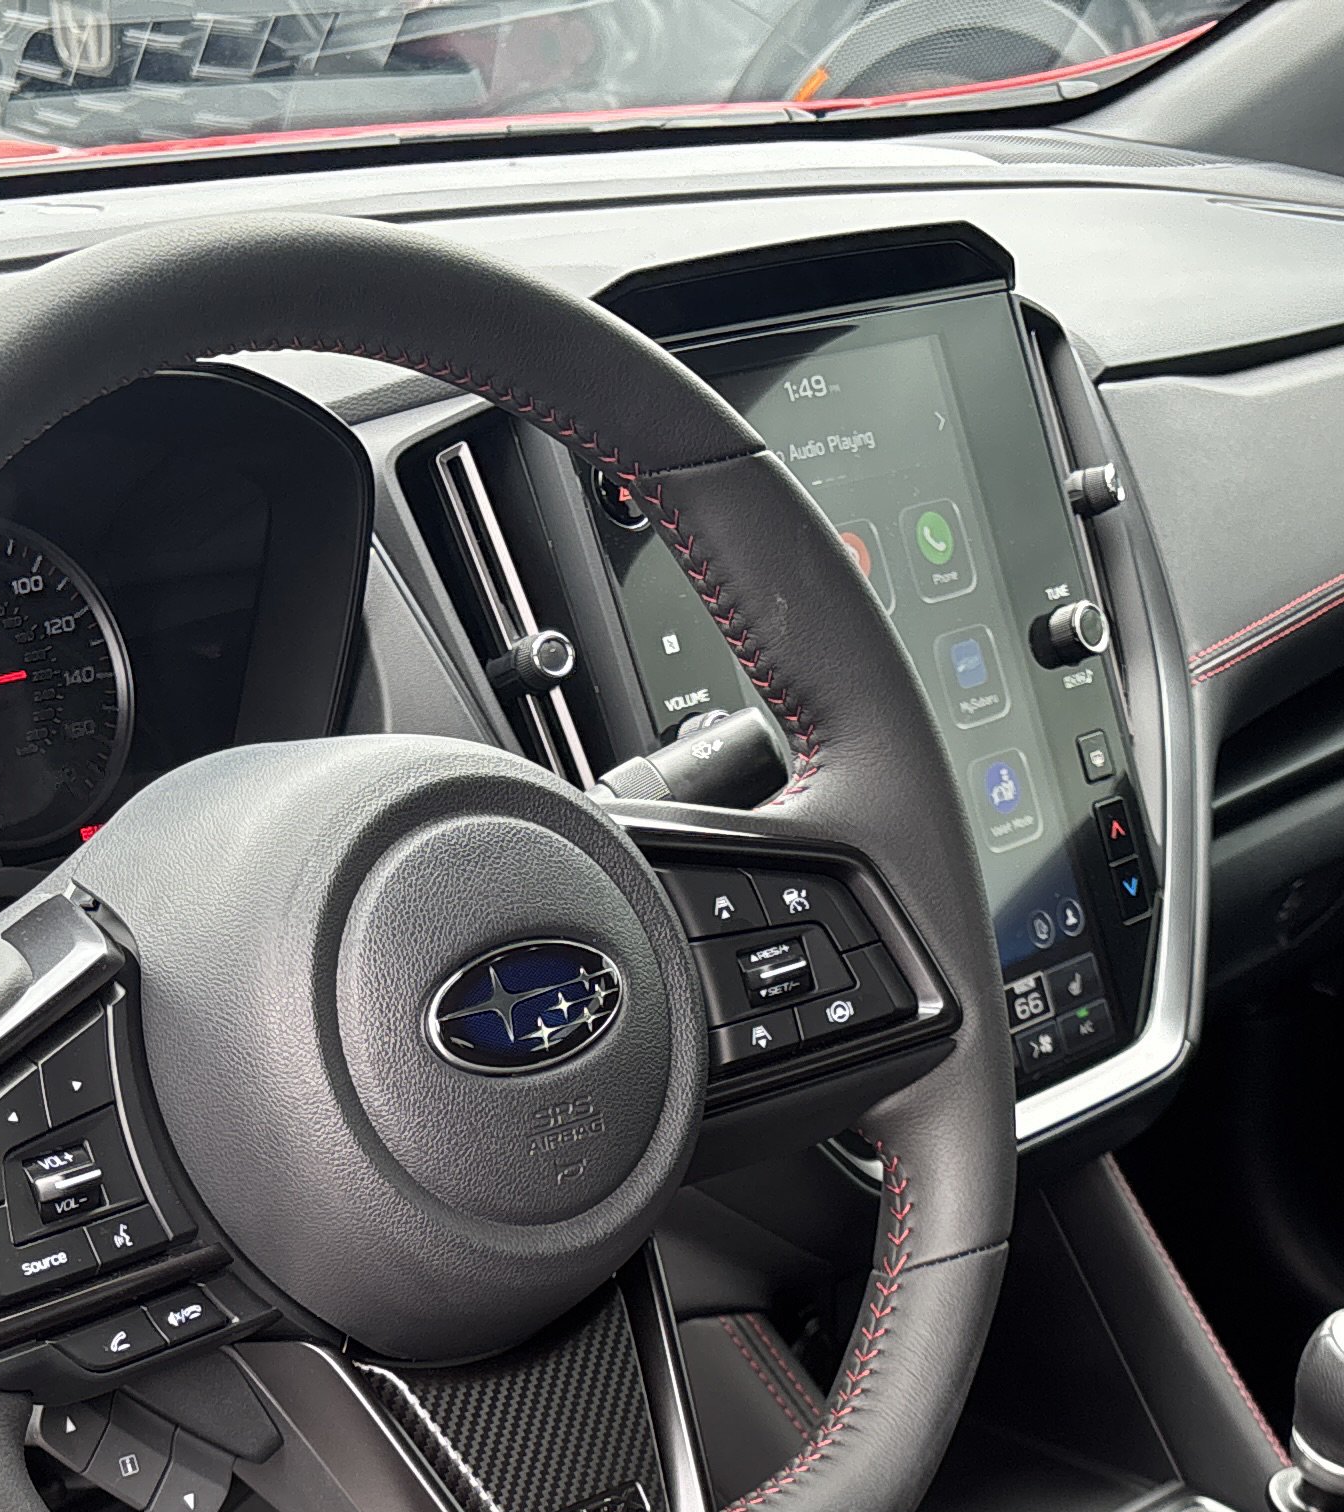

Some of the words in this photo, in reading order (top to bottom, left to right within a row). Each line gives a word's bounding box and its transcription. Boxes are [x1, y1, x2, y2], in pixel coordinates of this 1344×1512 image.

[784, 375, 827, 401] 1:49
[789, 440, 825, 461] Audio
[827, 431, 876, 452] Playing
[11, 575, 44, 595] 100
[44, 615, 75, 635] 120
[63, 666, 95, 686] 140
[663, 688, 711, 712] VOLUME
[1014, 991, 1045, 1020] 66
[21, 1252, 67, 1276] Source
